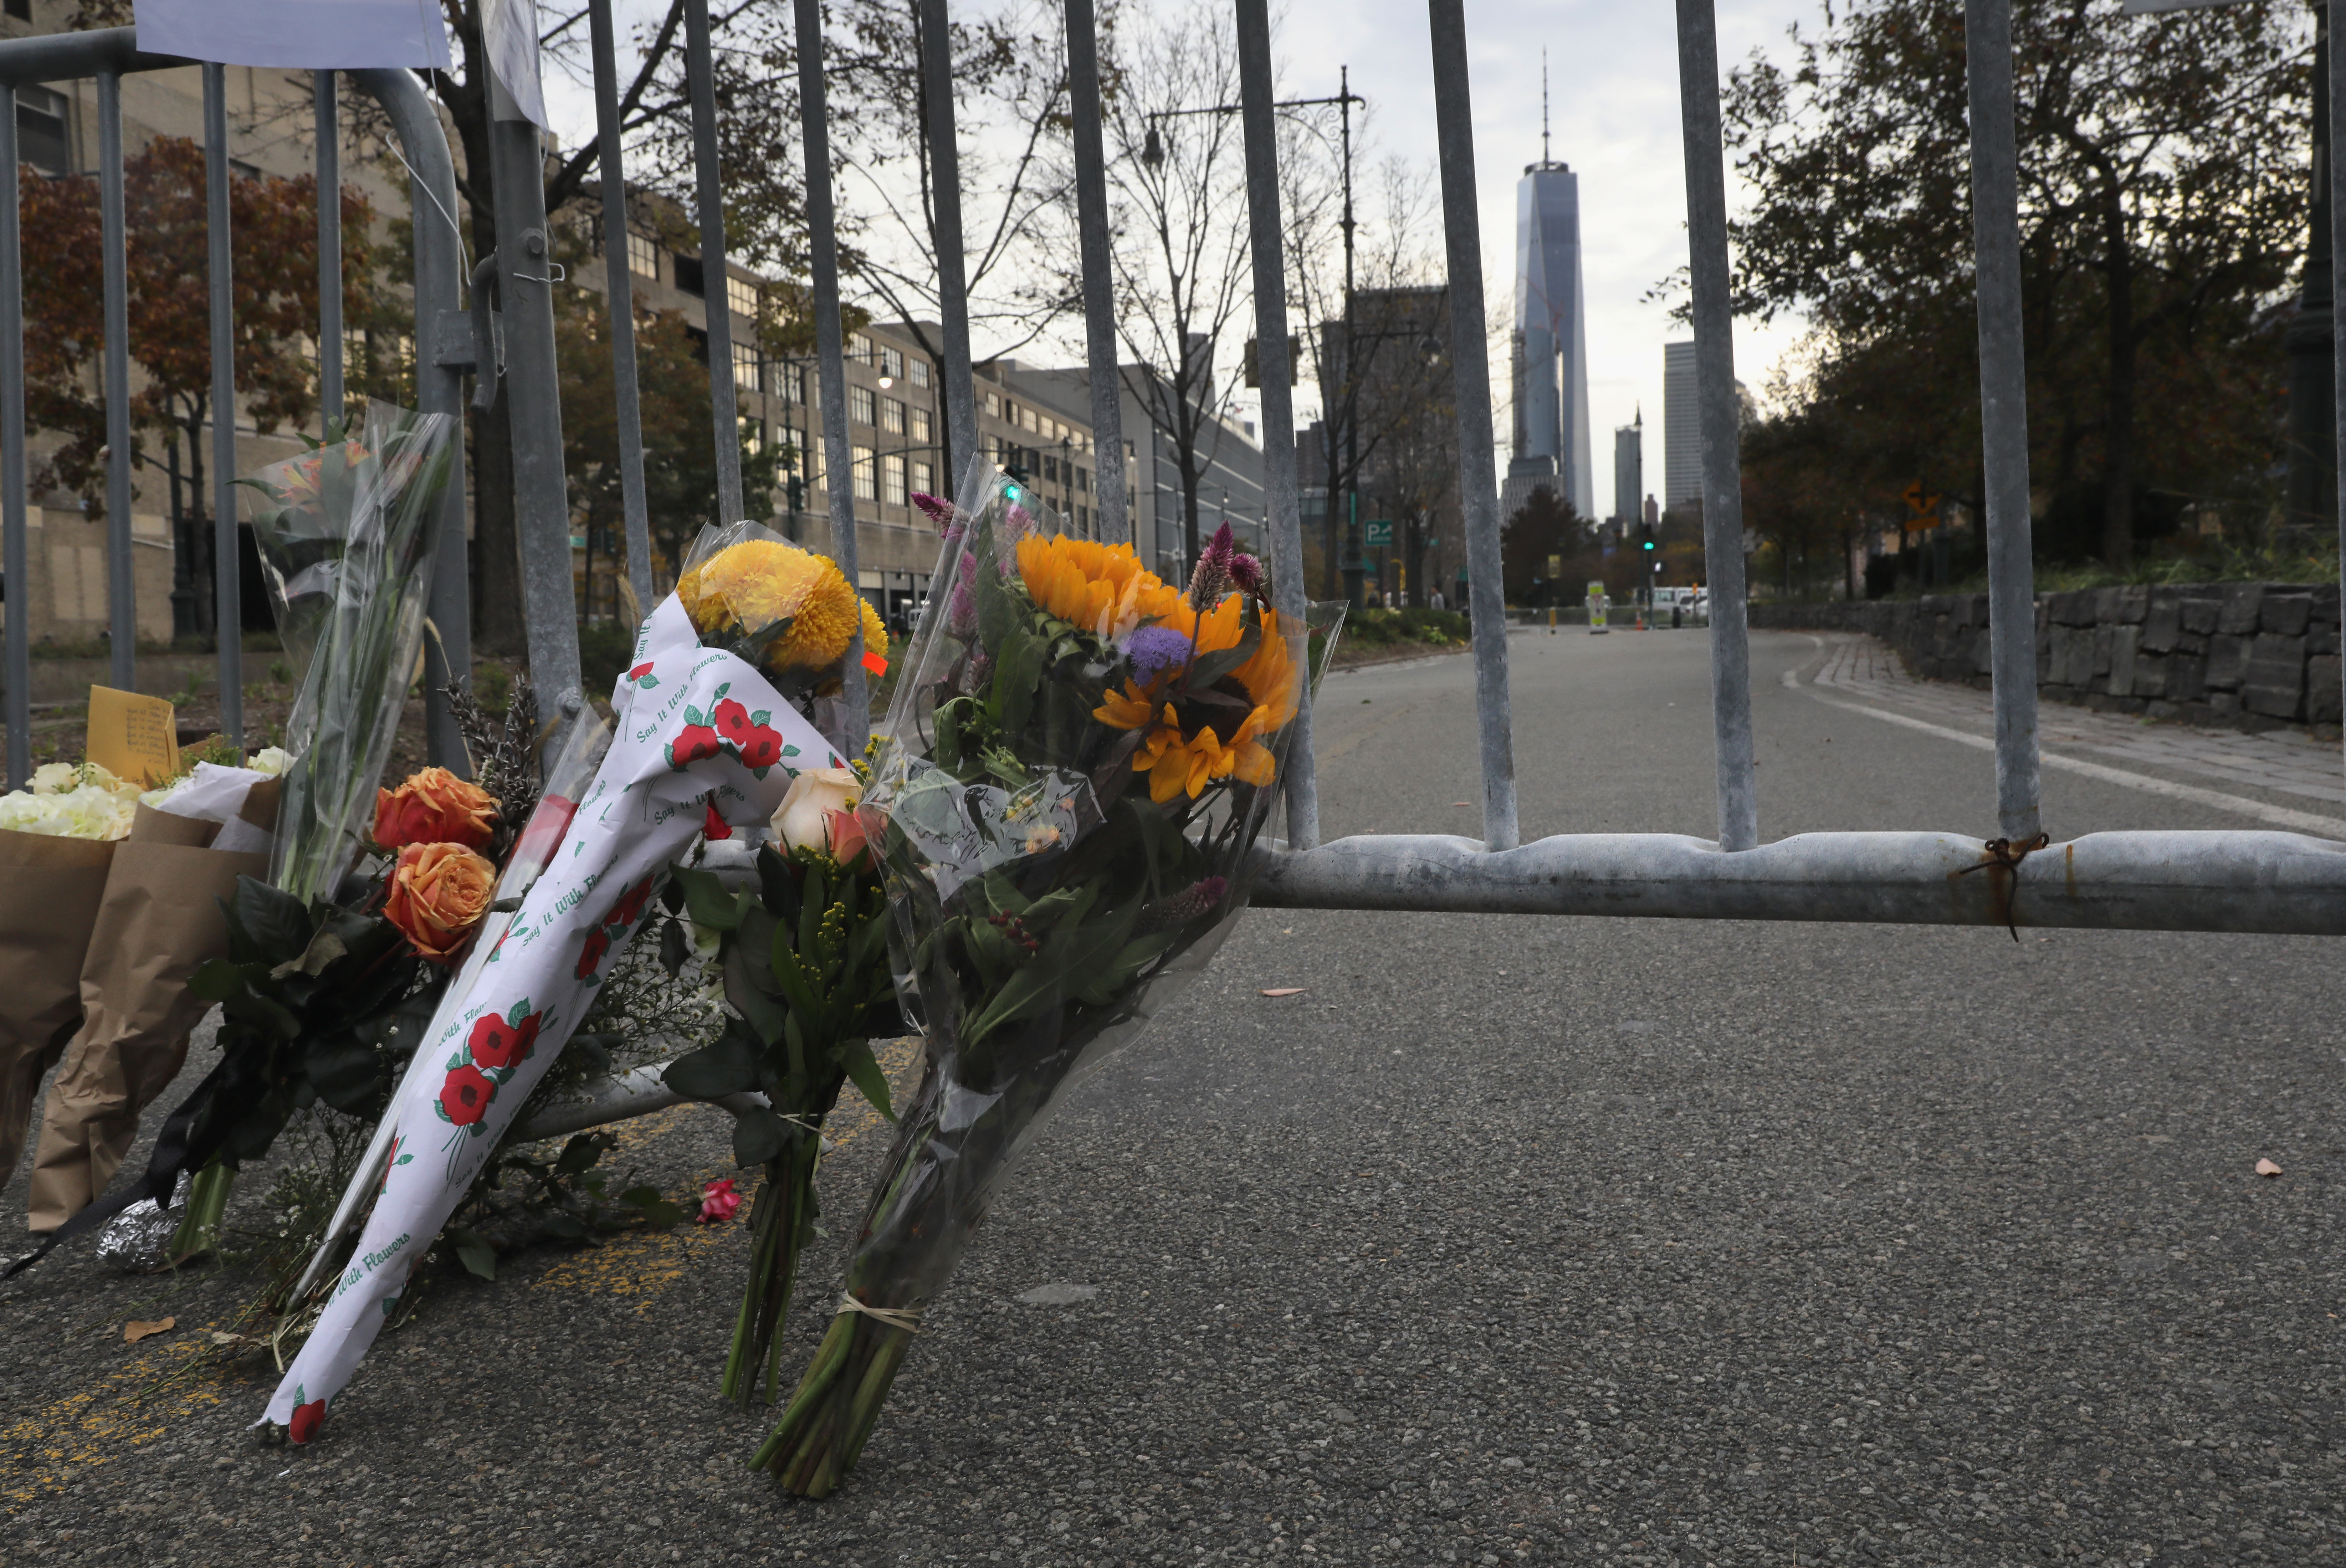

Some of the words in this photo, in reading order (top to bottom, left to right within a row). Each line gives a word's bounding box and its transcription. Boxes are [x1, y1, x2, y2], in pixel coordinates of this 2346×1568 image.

[1368, 524, 1380, 542] P
[633, 639, 649, 660] Say
[636, 723, 657, 743] Say
[657, 709, 668, 722] It
[578, 780, 606, 815] Flowers
[654, 806, 675, 825] Say
[680, 800, 692, 810] It
[523, 929, 541, 946] Say
[543, 914, 553, 925] It
[555, 888, 584, 914] With
[455, 1166, 472, 1188] Say
[476, 1152, 484, 1163] It
[338, 1266, 363, 1296] With
[362, 1233, 411, 1272] Flowers
